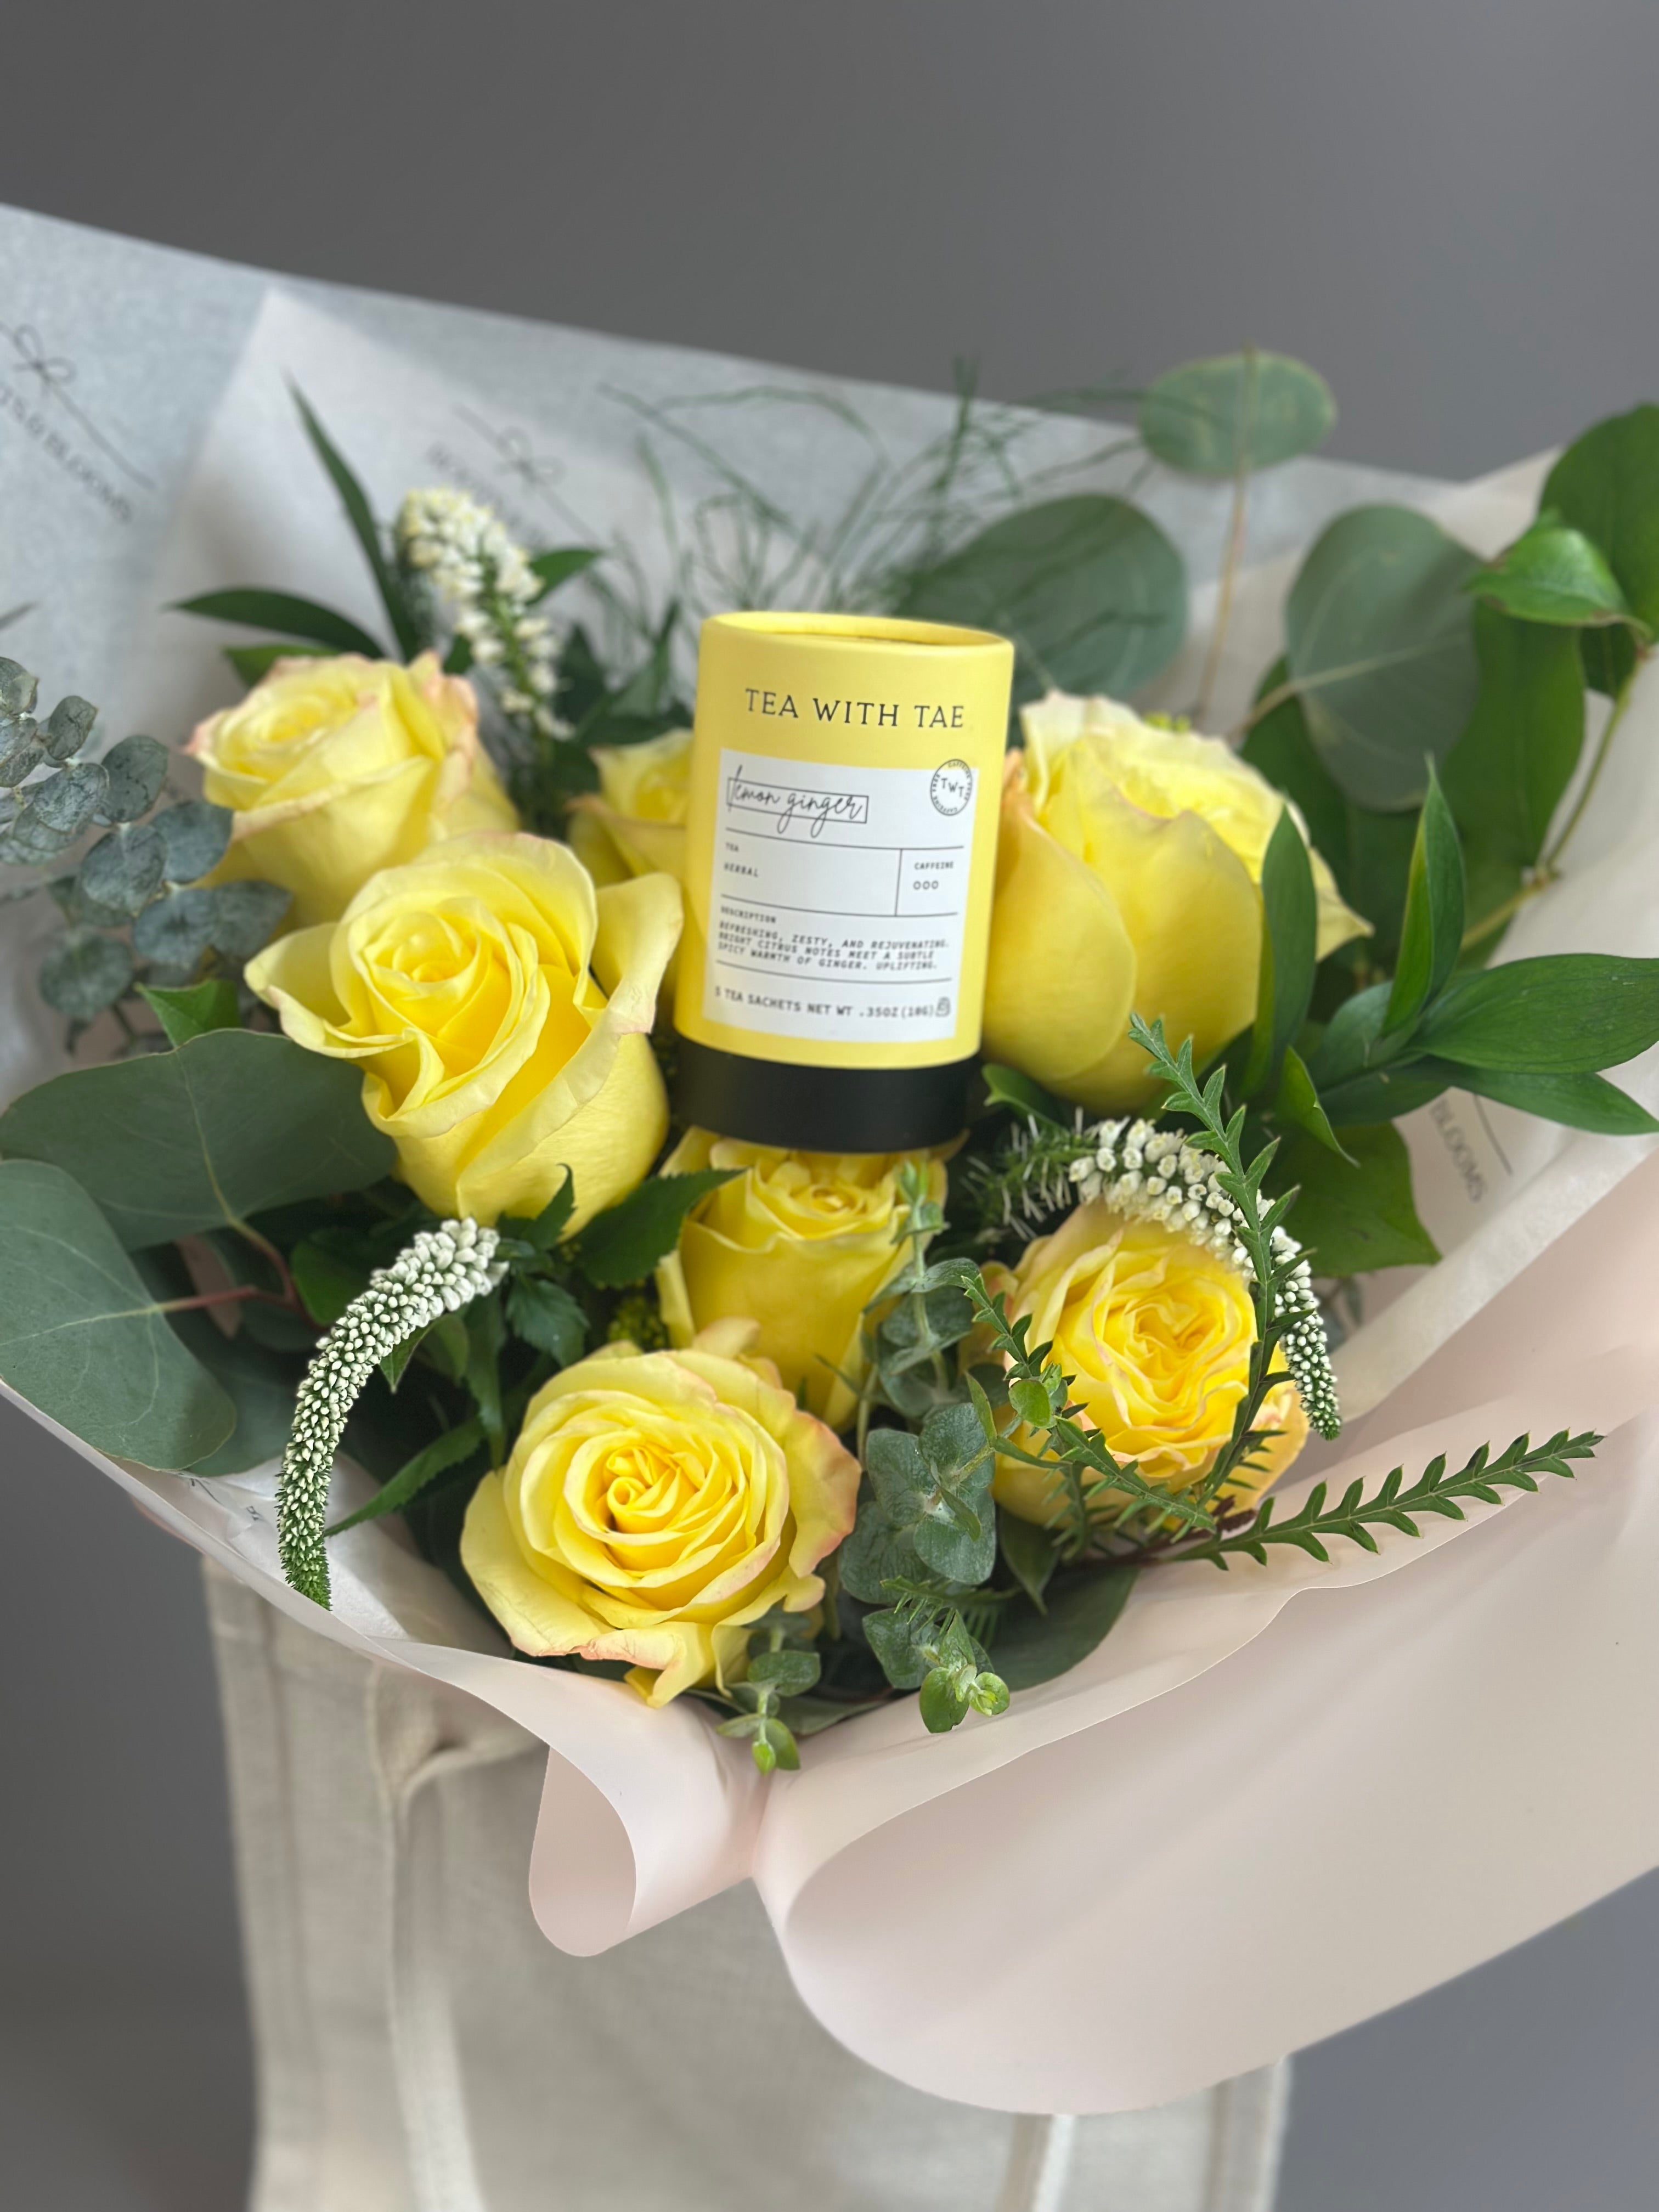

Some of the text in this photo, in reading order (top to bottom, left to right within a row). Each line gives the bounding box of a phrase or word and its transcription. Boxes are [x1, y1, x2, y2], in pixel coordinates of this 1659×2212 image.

[745, 688, 964, 728] TEA WITH TAE
[728, 764, 862, 838] lemon ginger
[726, 842, 739, 852] TEA
[724, 862, 758, 877] HERBAL
[914, 861, 954, 870] CAFFEINE
[721, 906, 776, 923] DESCRIPTION
[719, 920, 950, 950] REFRESHING, ZESTY, AND REJUVENATING.
[719, 932, 934, 960] BRIGHT CITRUS NOTES MEET A SUBTLE
[718, 941, 938, 970] SPICY WARMTH OF GINGER. UPLIFTING.
[725, 988, 743, 1002] TEA
[748, 994, 802, 1012] SACHETS
[807, 1003, 831, 1014] NET
[836, 1005, 853, 1016] WT
[1429, 1098, 1489, 1204] BLOOMS
